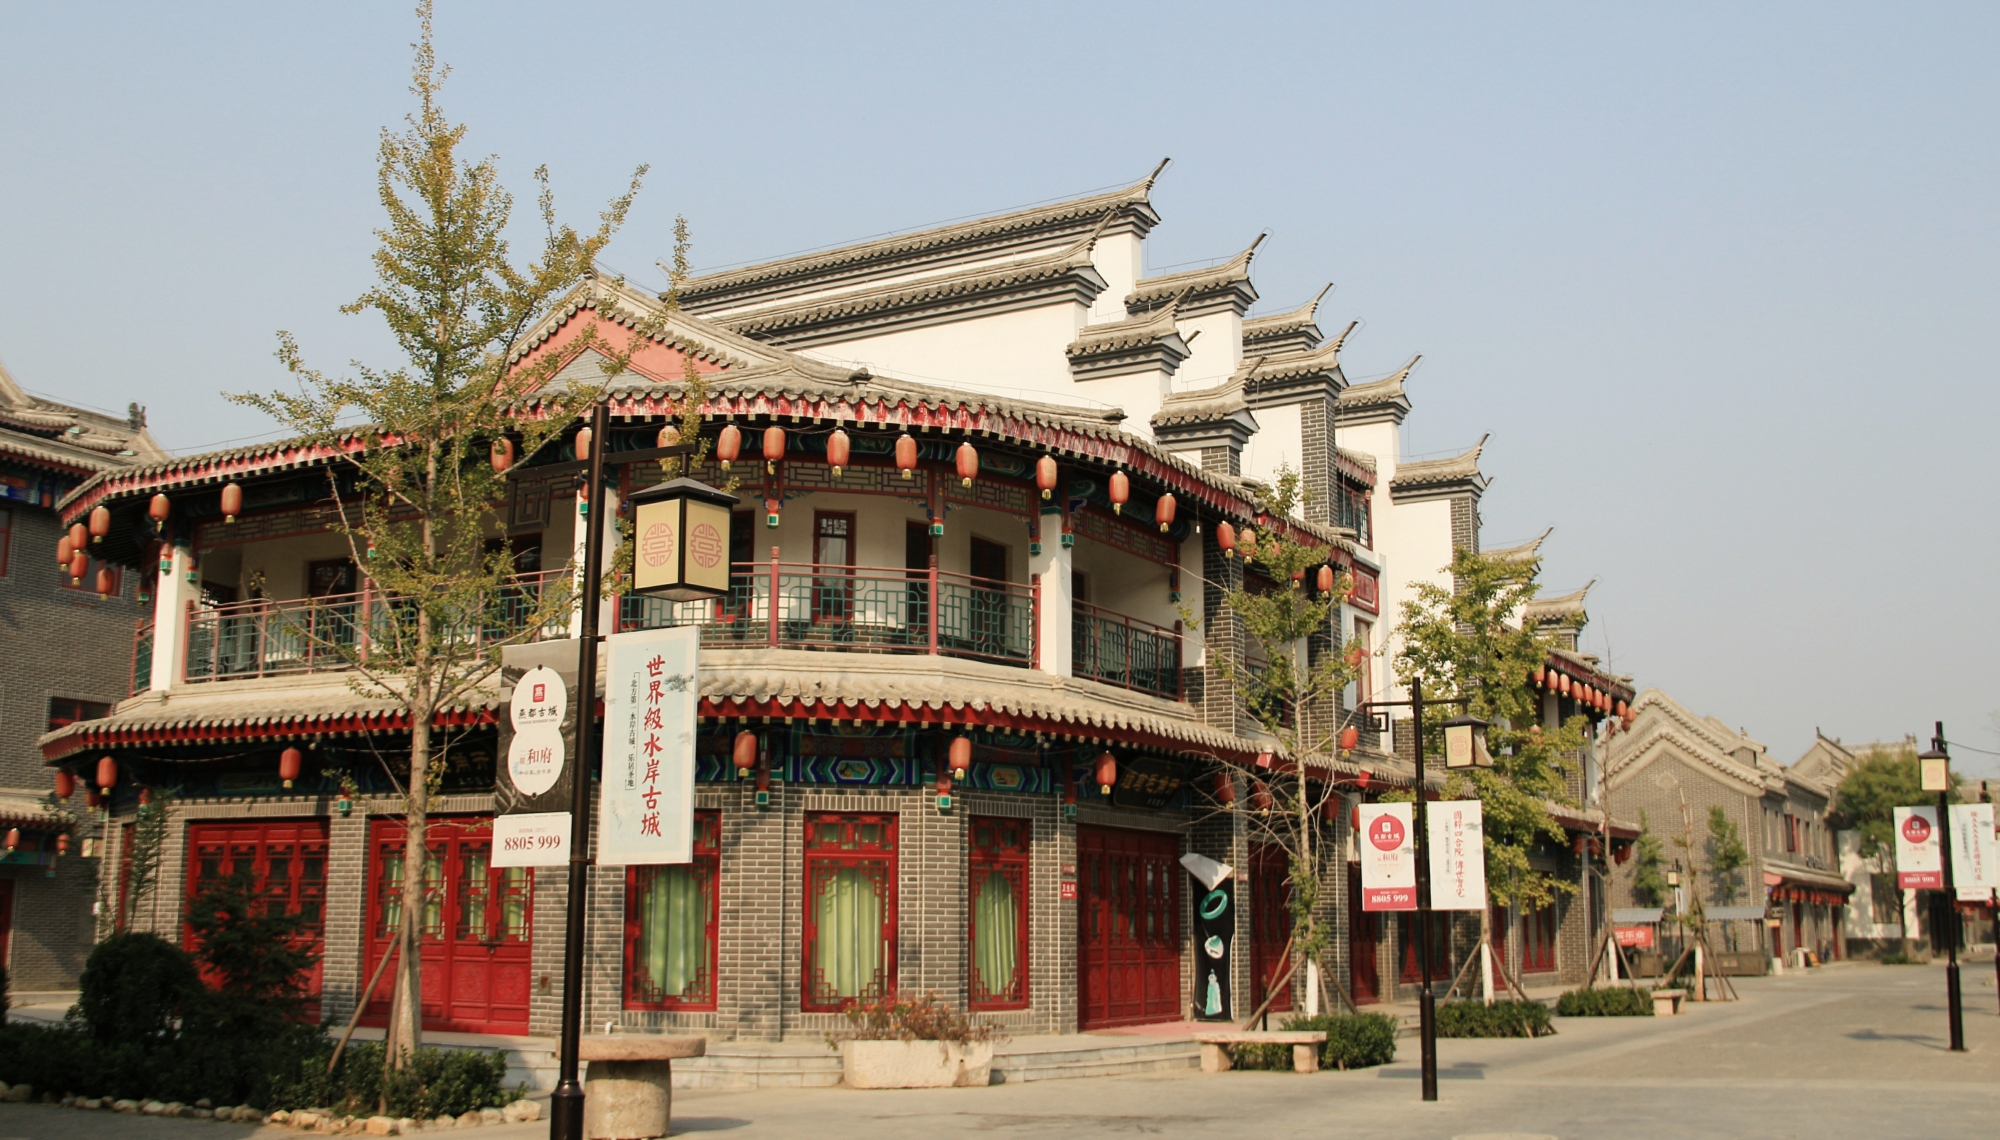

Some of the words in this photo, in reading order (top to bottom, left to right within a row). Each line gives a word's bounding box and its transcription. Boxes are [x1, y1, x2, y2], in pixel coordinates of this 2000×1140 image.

[641, 654, 666, 838] 世界級水岸古城
[527, 747, 553, 765] 和府
[504, 836, 534, 851] 8805
[538, 835, 561, 850] 999
[1371, 894, 1392, 903] 8805
[1393, 893, 1409, 902] 999
